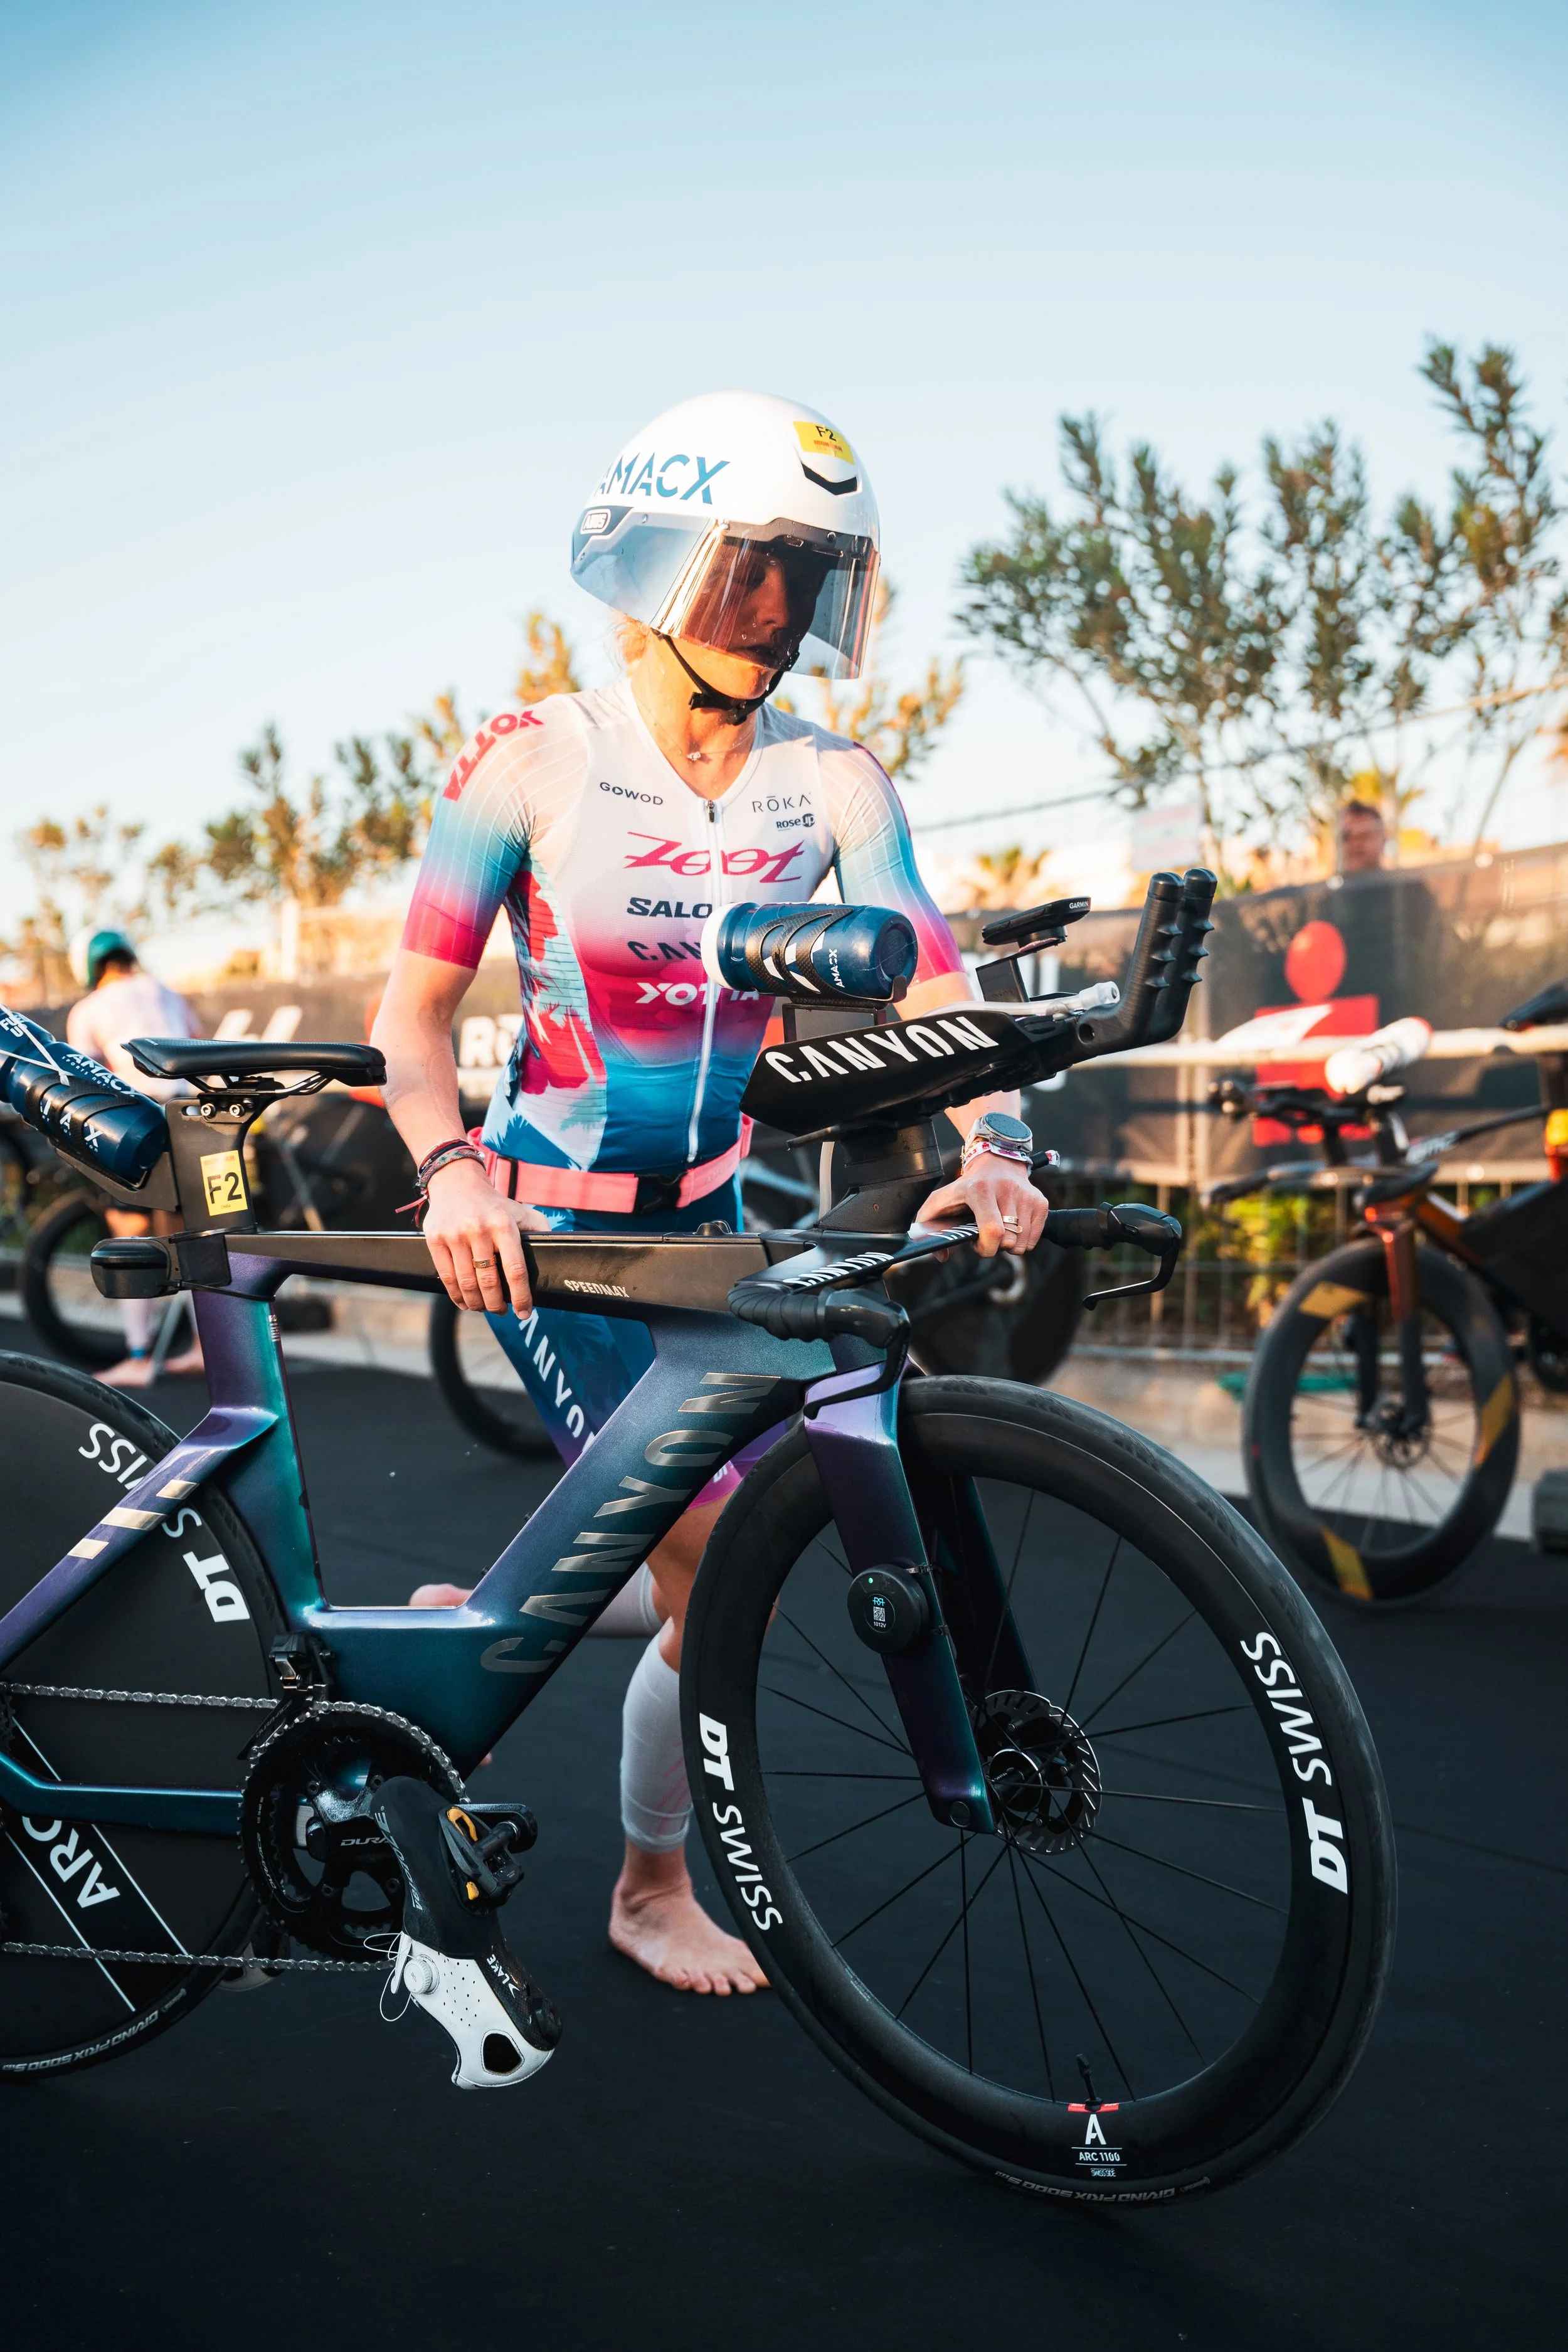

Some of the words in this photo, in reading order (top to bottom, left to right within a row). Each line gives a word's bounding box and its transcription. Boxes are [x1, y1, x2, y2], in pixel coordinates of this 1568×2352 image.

[815, 425, 837, 442] F2
[443, 710, 544, 802] YOTTA
[600, 781, 663, 805] GOWOD
[1069, 901, 1089, 909] GARMIN
[829, 948, 845, 988] AMACX
[61, 1056, 89, 1076] SPORTS
[765, 1017, 999, 1083] CANYON
[207, 1172, 242, 1204] F2
[782, 1252, 894, 1286] CANYON
[564, 1279, 630, 1299] SPEEDMAX
[78, 1422, 203, 1539] SISS
[480, 1372, 781, 1673] CANYON
[183, 1551, 250, 1623] DT
[1240, 1631, 1332, 1786] SWISS
[699, 1712, 734, 1791] DT
[1302, 1797, 1348, 1895] DT
[712, 1802, 783, 1931] SWISS
[486, 1953, 510, 1986] LAKE
[113, 2010, 159, 2046] GRAND
[27, 2055, 73, 2072] 5000
[73, 2038, 112, 2062] PRIX
[1085, 2114, 1106, 2145] A
[1079, 2152, 1099, 2161] ARC
[1099, 2152, 1121, 2162] 1100
[1022, 2180, 1073, 2198] 5000
[1074, 2190, 1118, 2202] PRIX
[1118, 2187, 1175, 2202] GRAND
